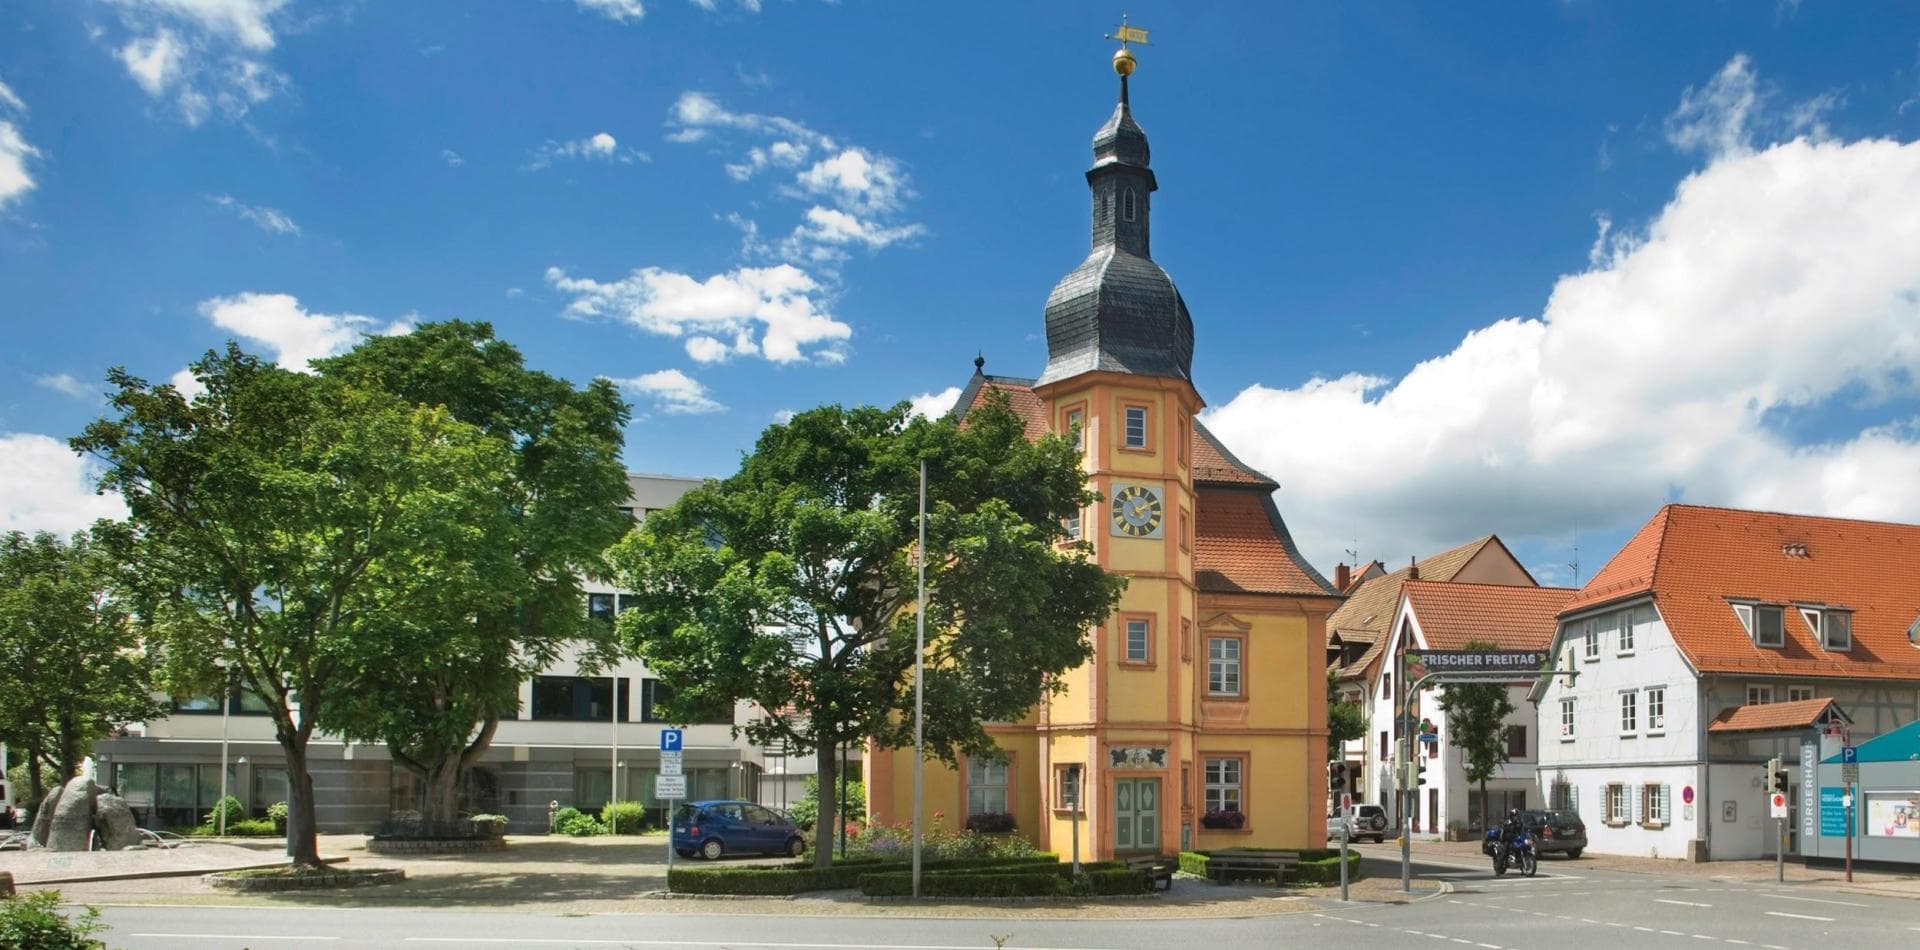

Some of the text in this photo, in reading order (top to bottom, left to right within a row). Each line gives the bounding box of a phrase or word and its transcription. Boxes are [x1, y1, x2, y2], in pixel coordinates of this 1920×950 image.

[1421, 654, 1536, 666] FRISCHER FREITAG
[665, 732, 678, 749] P
[1845, 749, 1854, 762] P
